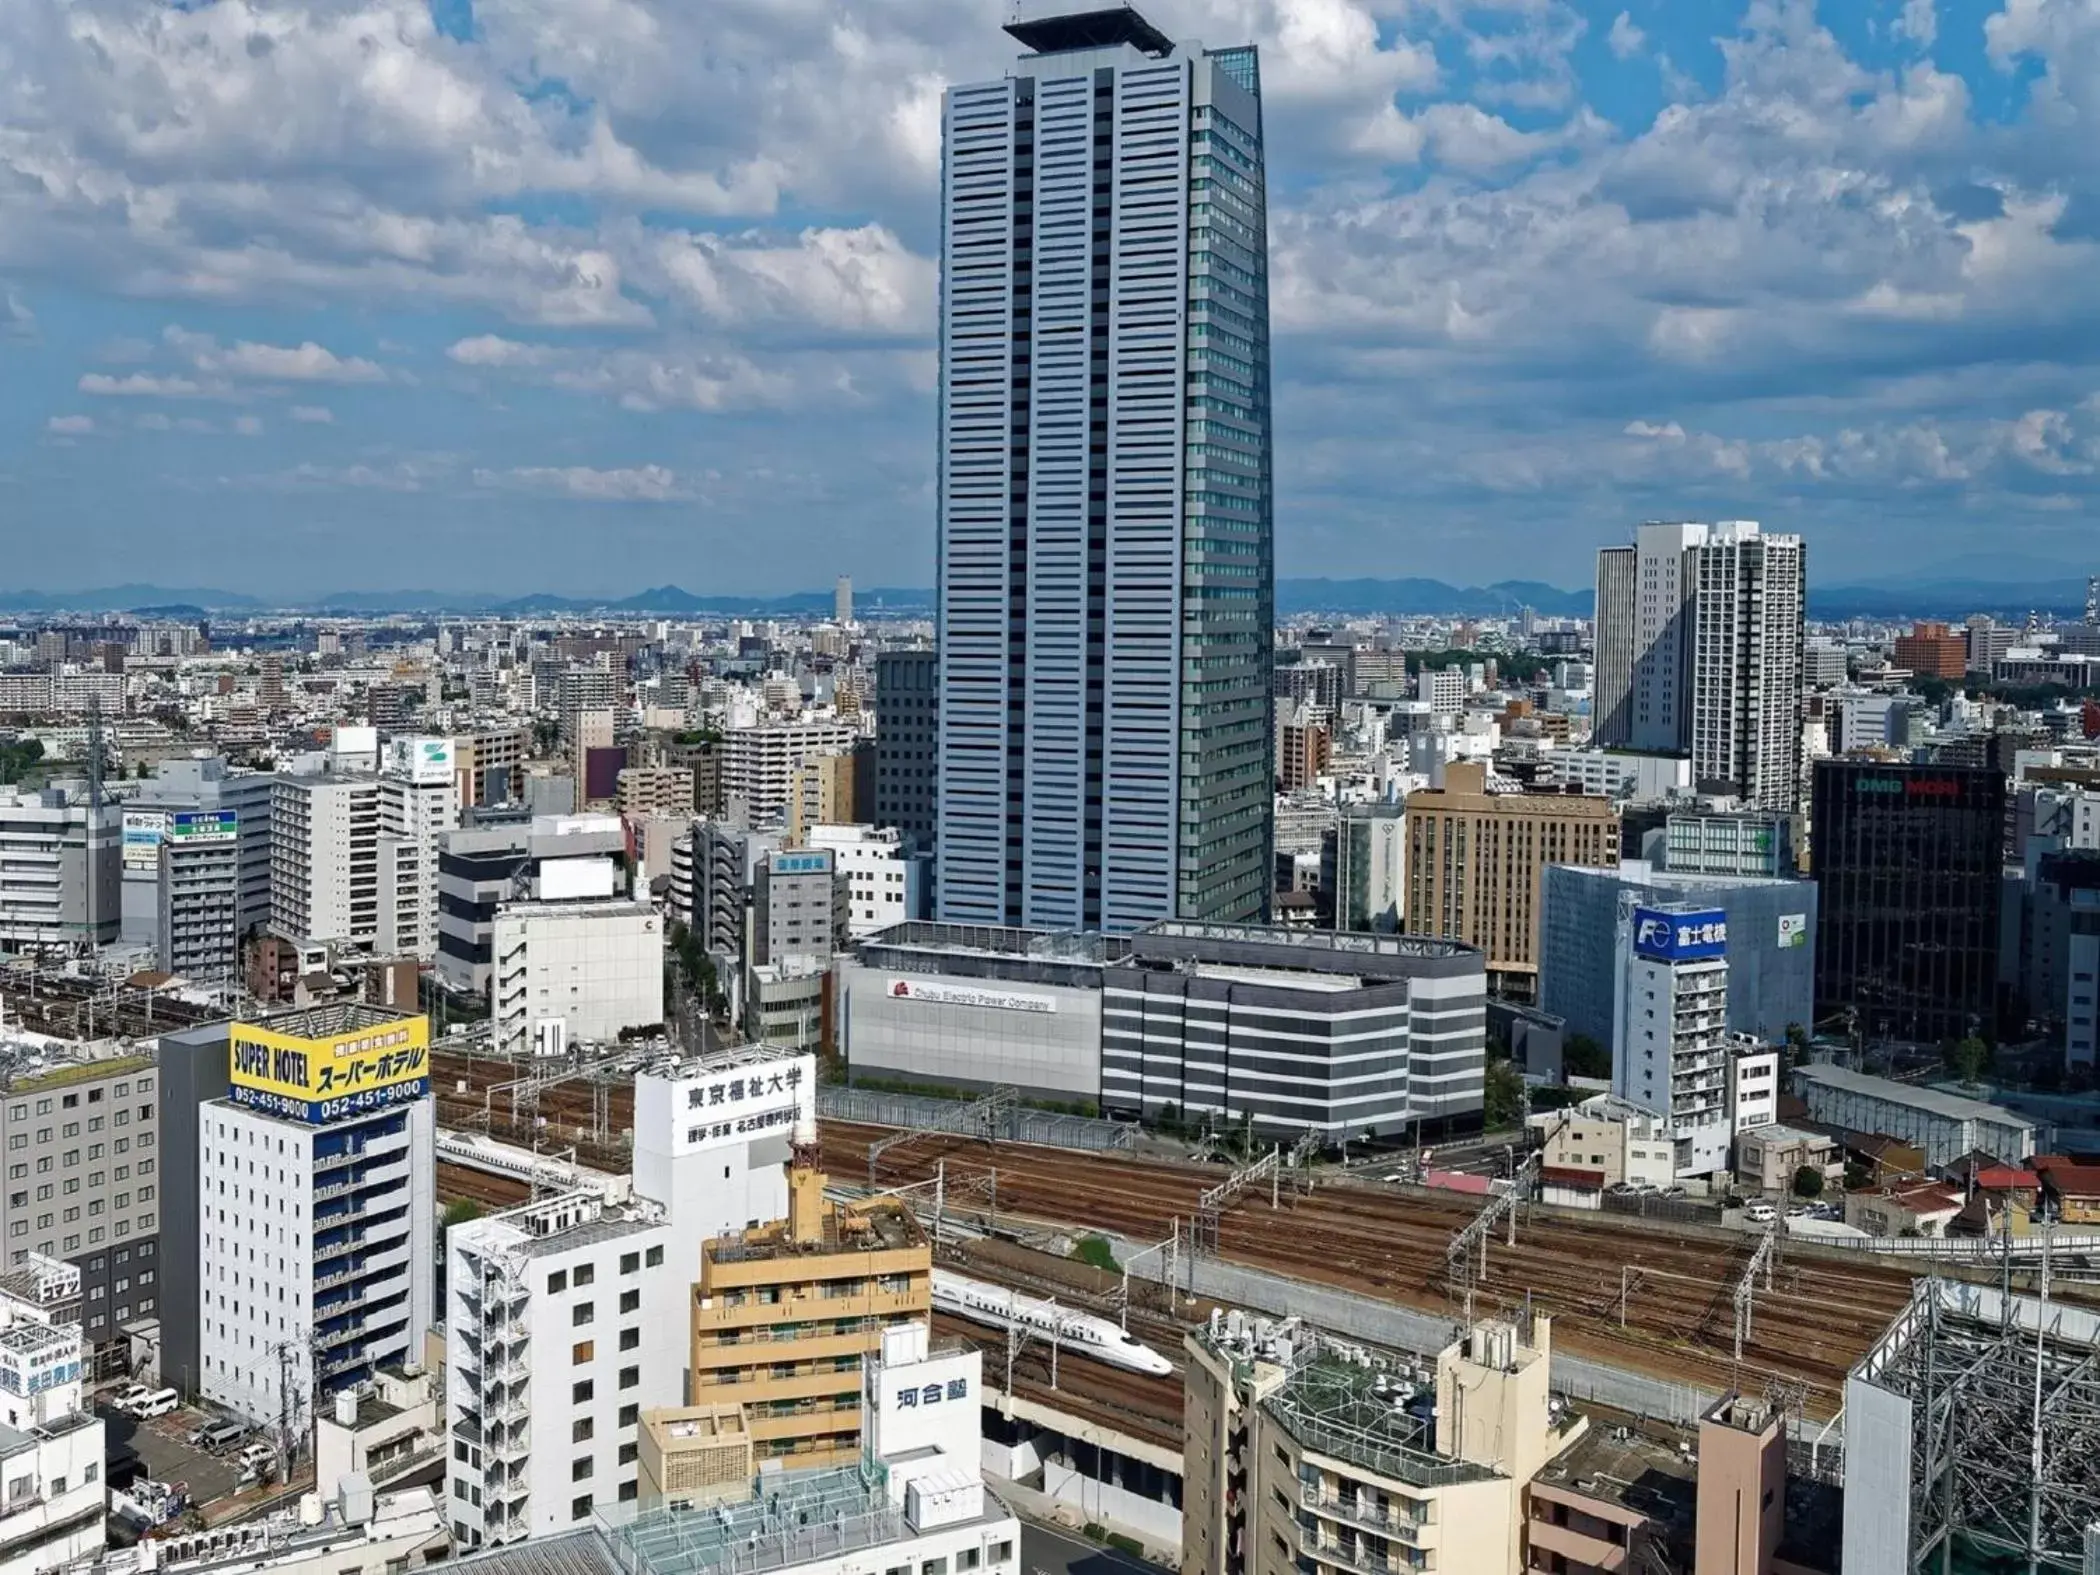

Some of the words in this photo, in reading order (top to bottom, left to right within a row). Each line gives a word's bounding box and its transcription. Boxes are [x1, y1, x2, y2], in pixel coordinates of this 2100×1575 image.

[1856, 779, 1902, 793] DMG
[915, 988, 940, 1001] Chubu
[943, 990, 977, 1003] Electric
[978, 994, 1007, 1006] Power
[1009, 997, 1050, 1011] Company
[234, 1040, 270, 1079] SUPER
[274, 1048, 310, 1088] HOTEL
[316, 1047, 426, 1094] スーパーホテル
[235, 1086, 309, 1118] 052-451-9000
[321, 1081, 421, 1118] 052-451-9000
[688, 1066, 802, 1110] 東京福祉大学
[43, 1281, 79, 1301] コマツ
[897, 1377, 967, 1411] 河合塾
